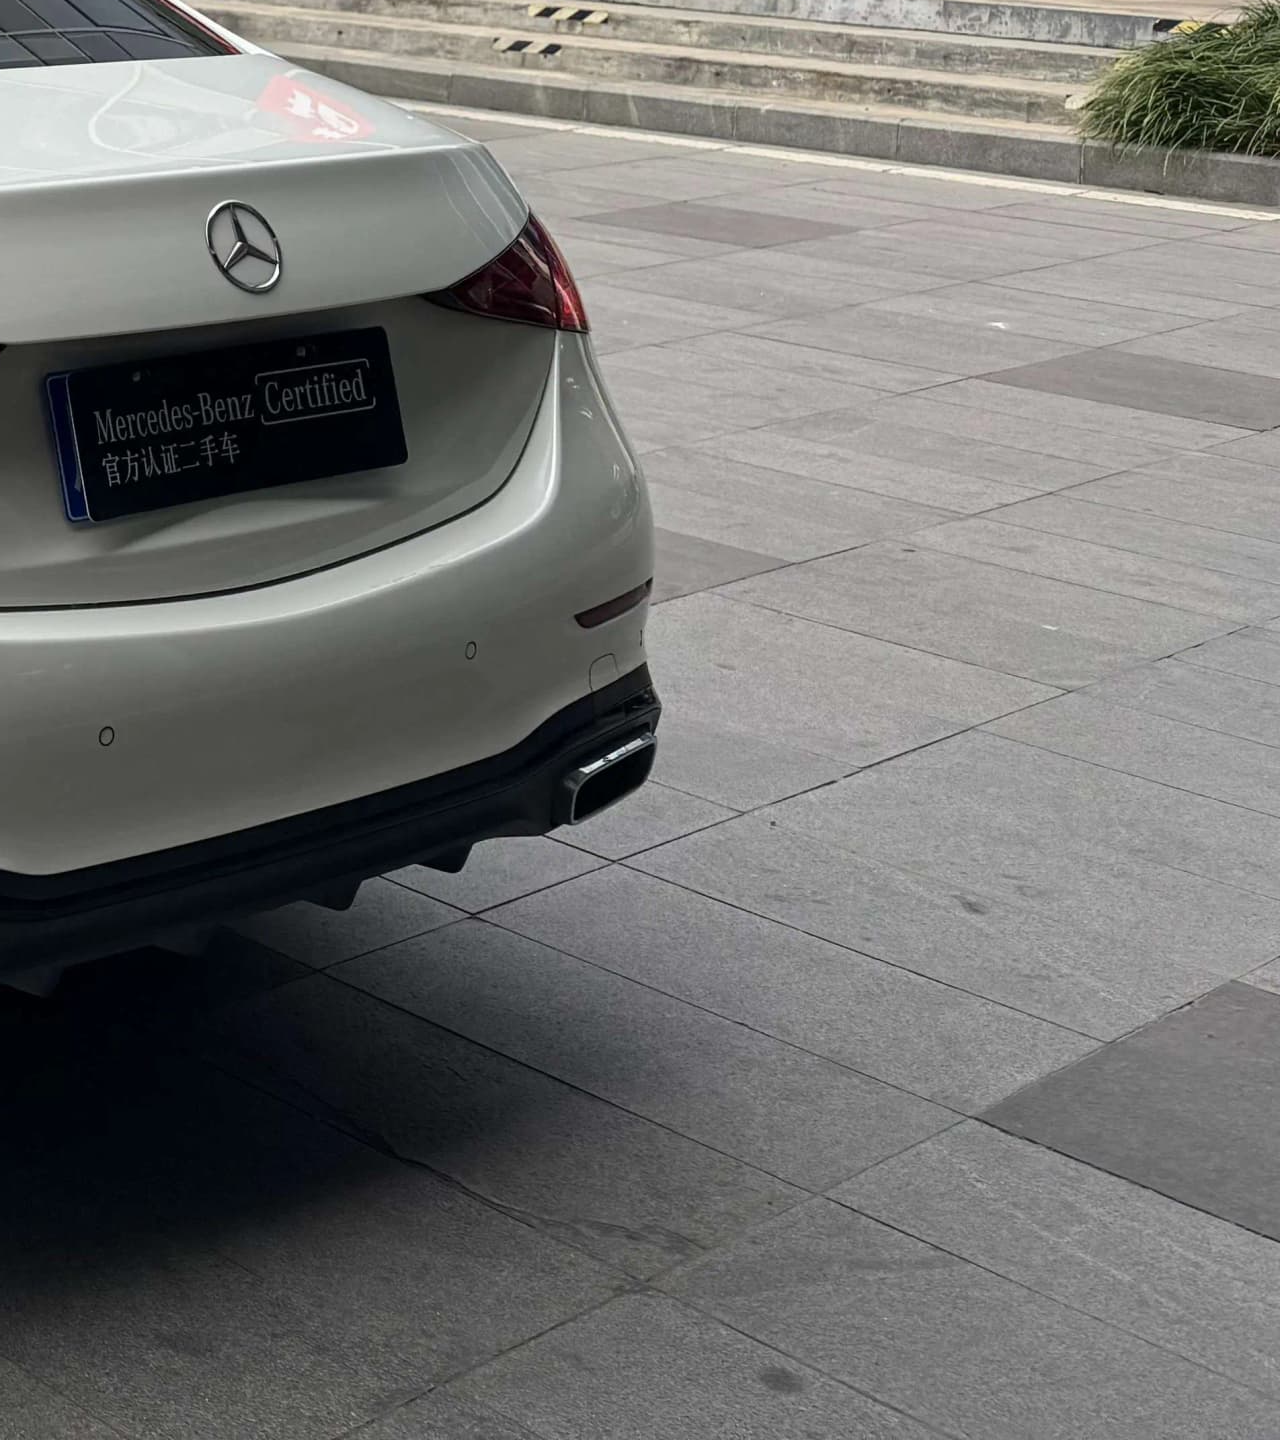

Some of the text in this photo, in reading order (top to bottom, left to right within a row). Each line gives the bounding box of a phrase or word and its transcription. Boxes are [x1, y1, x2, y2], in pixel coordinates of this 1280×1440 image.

[93, 368, 367, 445] Mercedes-Benz Certified
[101, 431, 241, 488] 官方认证二手车
